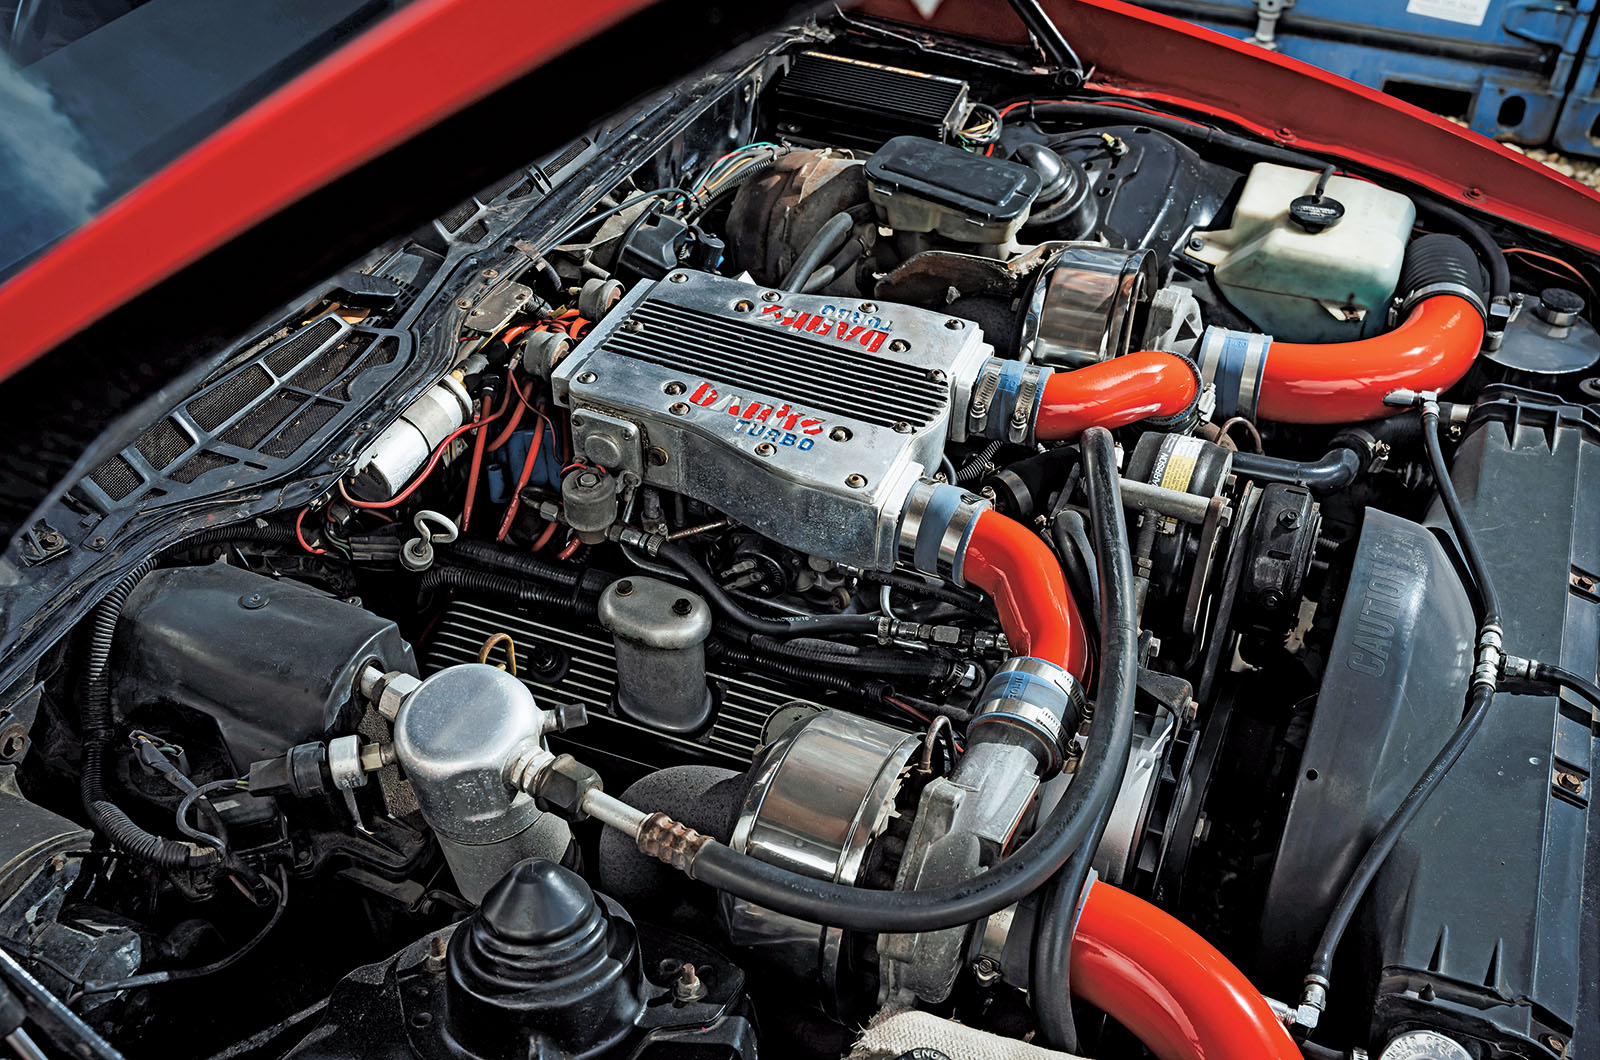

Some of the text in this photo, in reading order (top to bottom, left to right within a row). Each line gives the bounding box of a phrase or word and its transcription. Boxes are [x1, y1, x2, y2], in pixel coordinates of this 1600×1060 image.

[820, 304, 893, 332] TURBO
[688, 382, 826, 435] BANKS
[734, 418, 815, 451] TURBO
[1347, 558, 1407, 678] CAUTION
